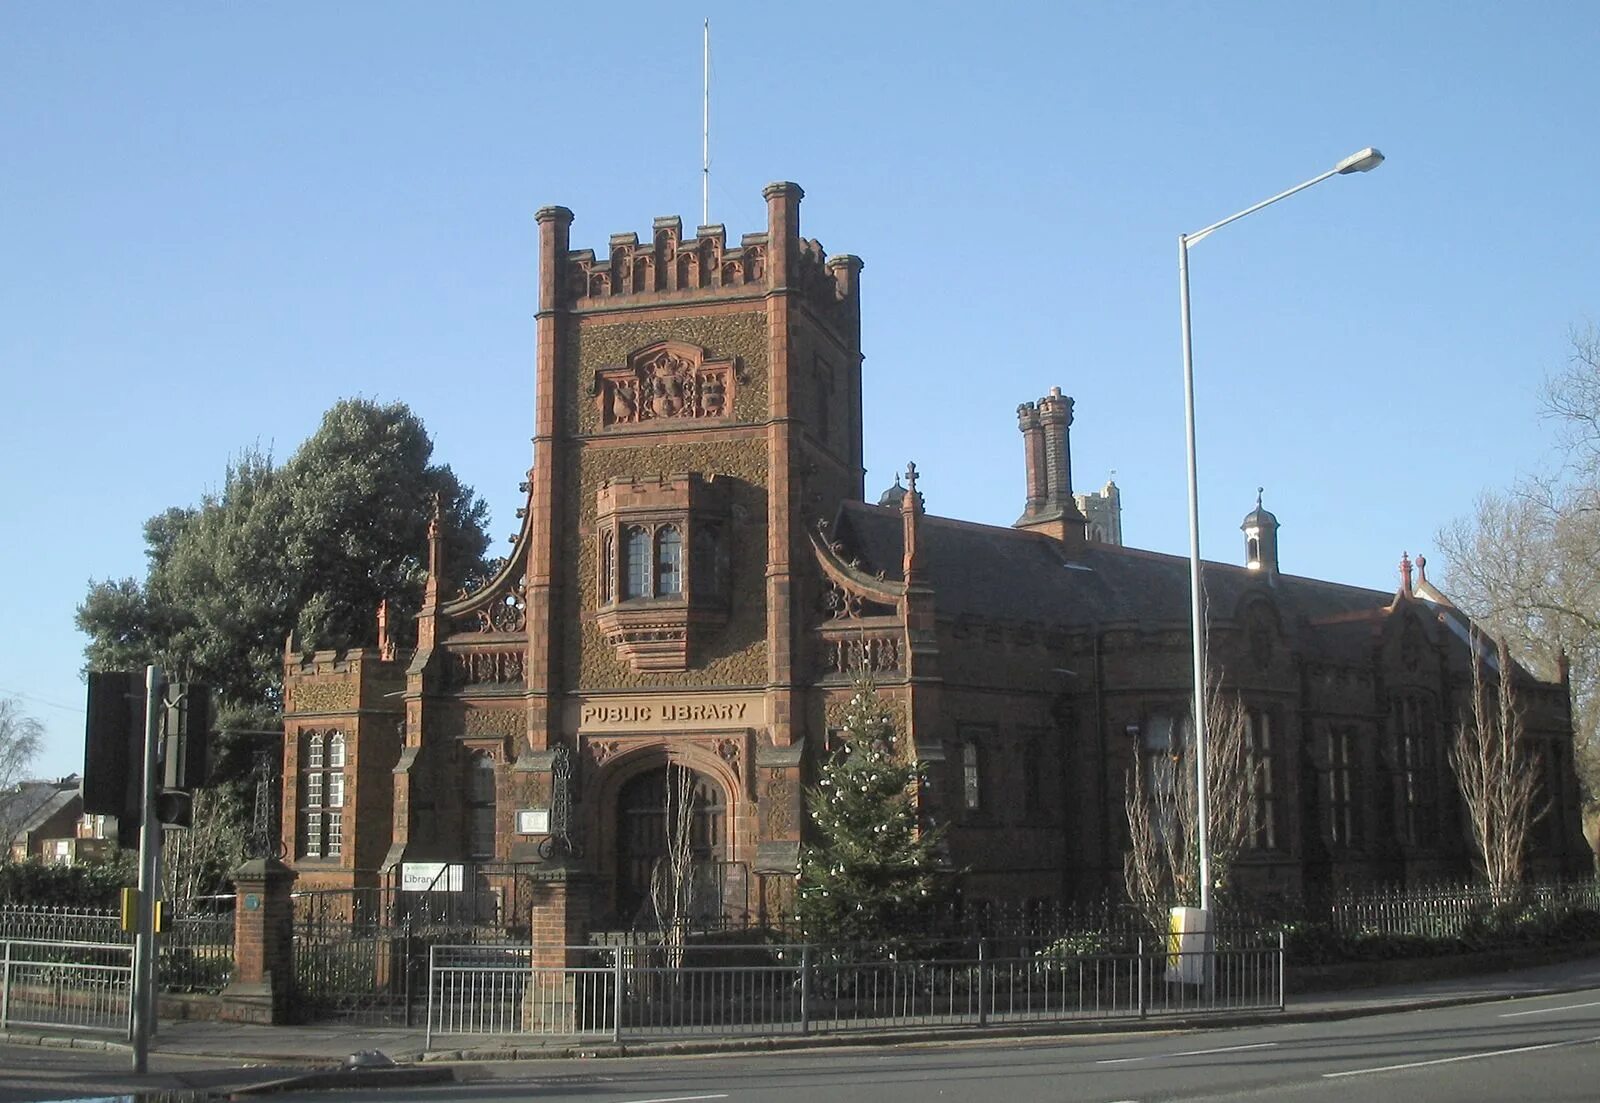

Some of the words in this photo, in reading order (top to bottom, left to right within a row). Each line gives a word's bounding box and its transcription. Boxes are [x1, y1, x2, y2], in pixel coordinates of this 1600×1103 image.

[585, 706, 651, 723] PUBLIC
[661, 703, 747, 721] LIBRARY
[404, 874, 435, 886] Library
